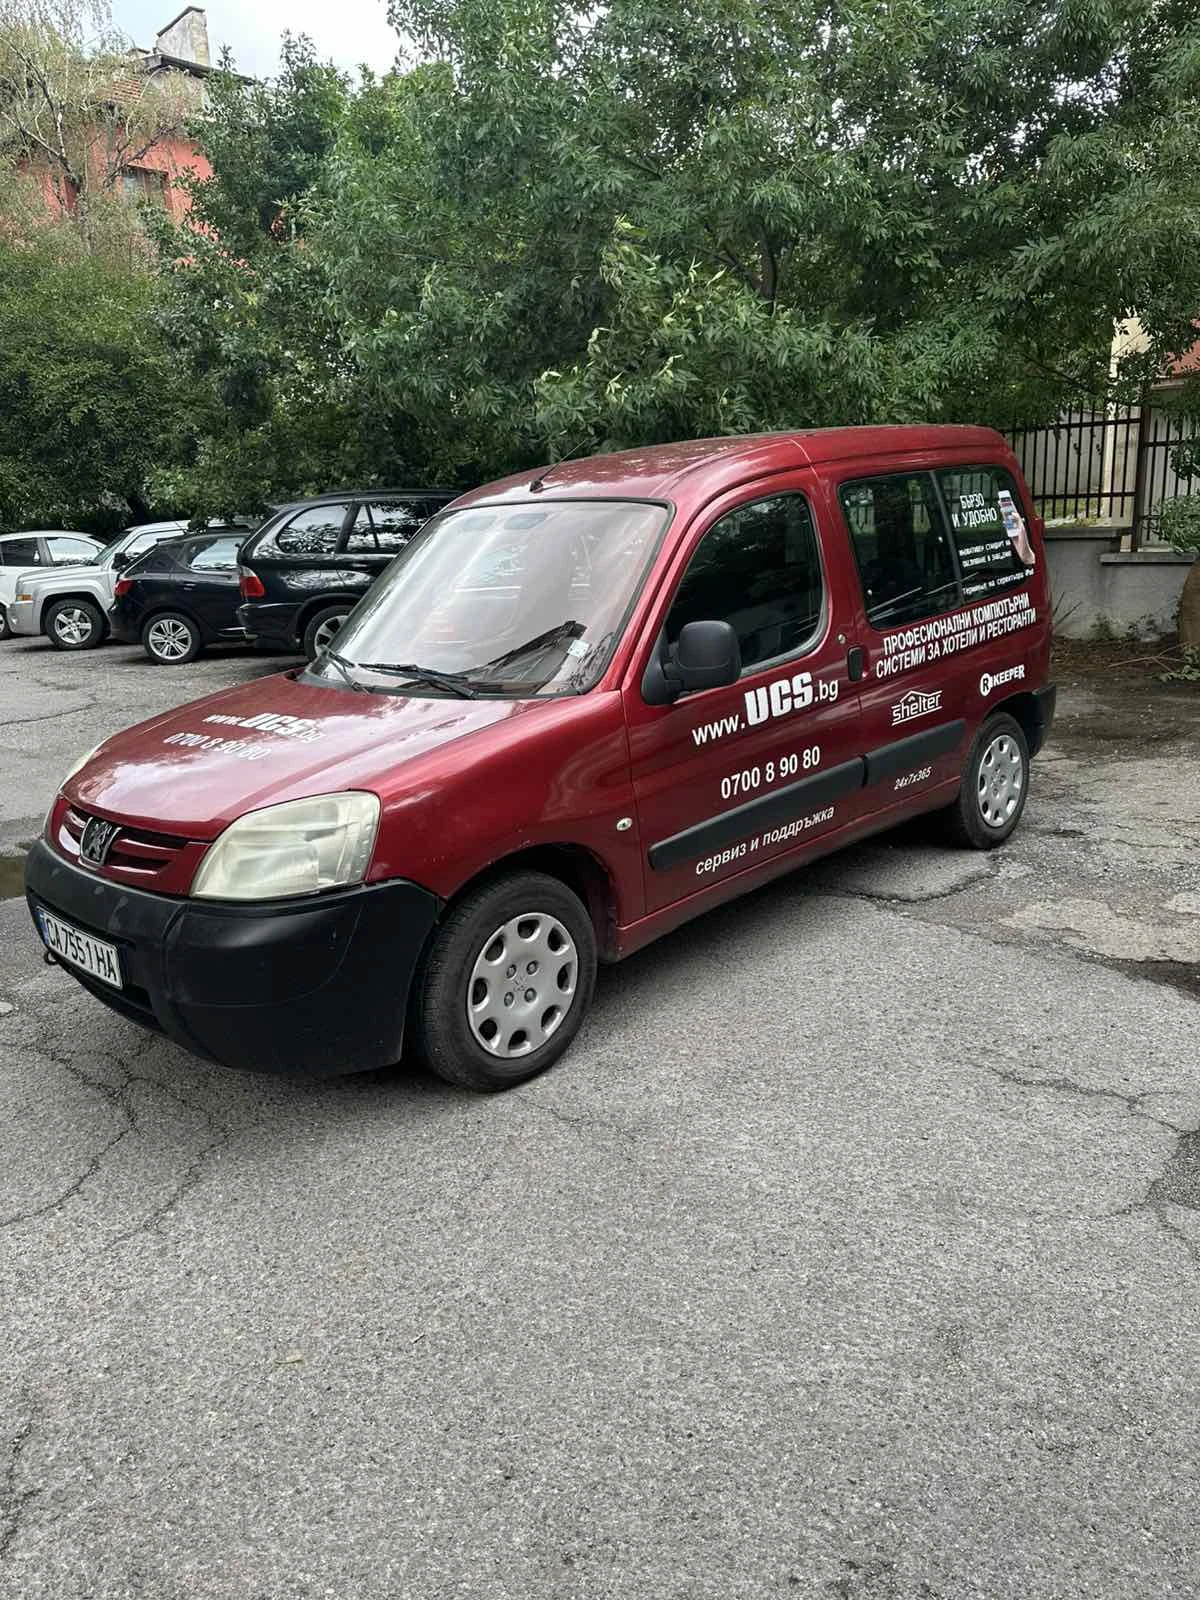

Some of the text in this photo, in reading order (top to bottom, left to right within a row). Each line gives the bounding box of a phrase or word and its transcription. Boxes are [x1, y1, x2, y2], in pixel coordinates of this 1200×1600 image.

[951, 507, 998, 528] И УДОБНО
[959, 493, 985, 509] БЪРЗО
[876, 608, 1036, 678] СИСТЕМИ ЗА ХОТЕЛИ И РЕСТОРАНТИ
[883, 592, 1030, 655] ПРОФЕСИОНАЛНИ КОМПЮТЪРНИ
[892, 694, 941, 722] shelter
[163, 733, 210, 747] 0700
[721, 746, 820, 799] 0700 8 90 80
[695, 806, 835, 874] сервиз и поддръжка
